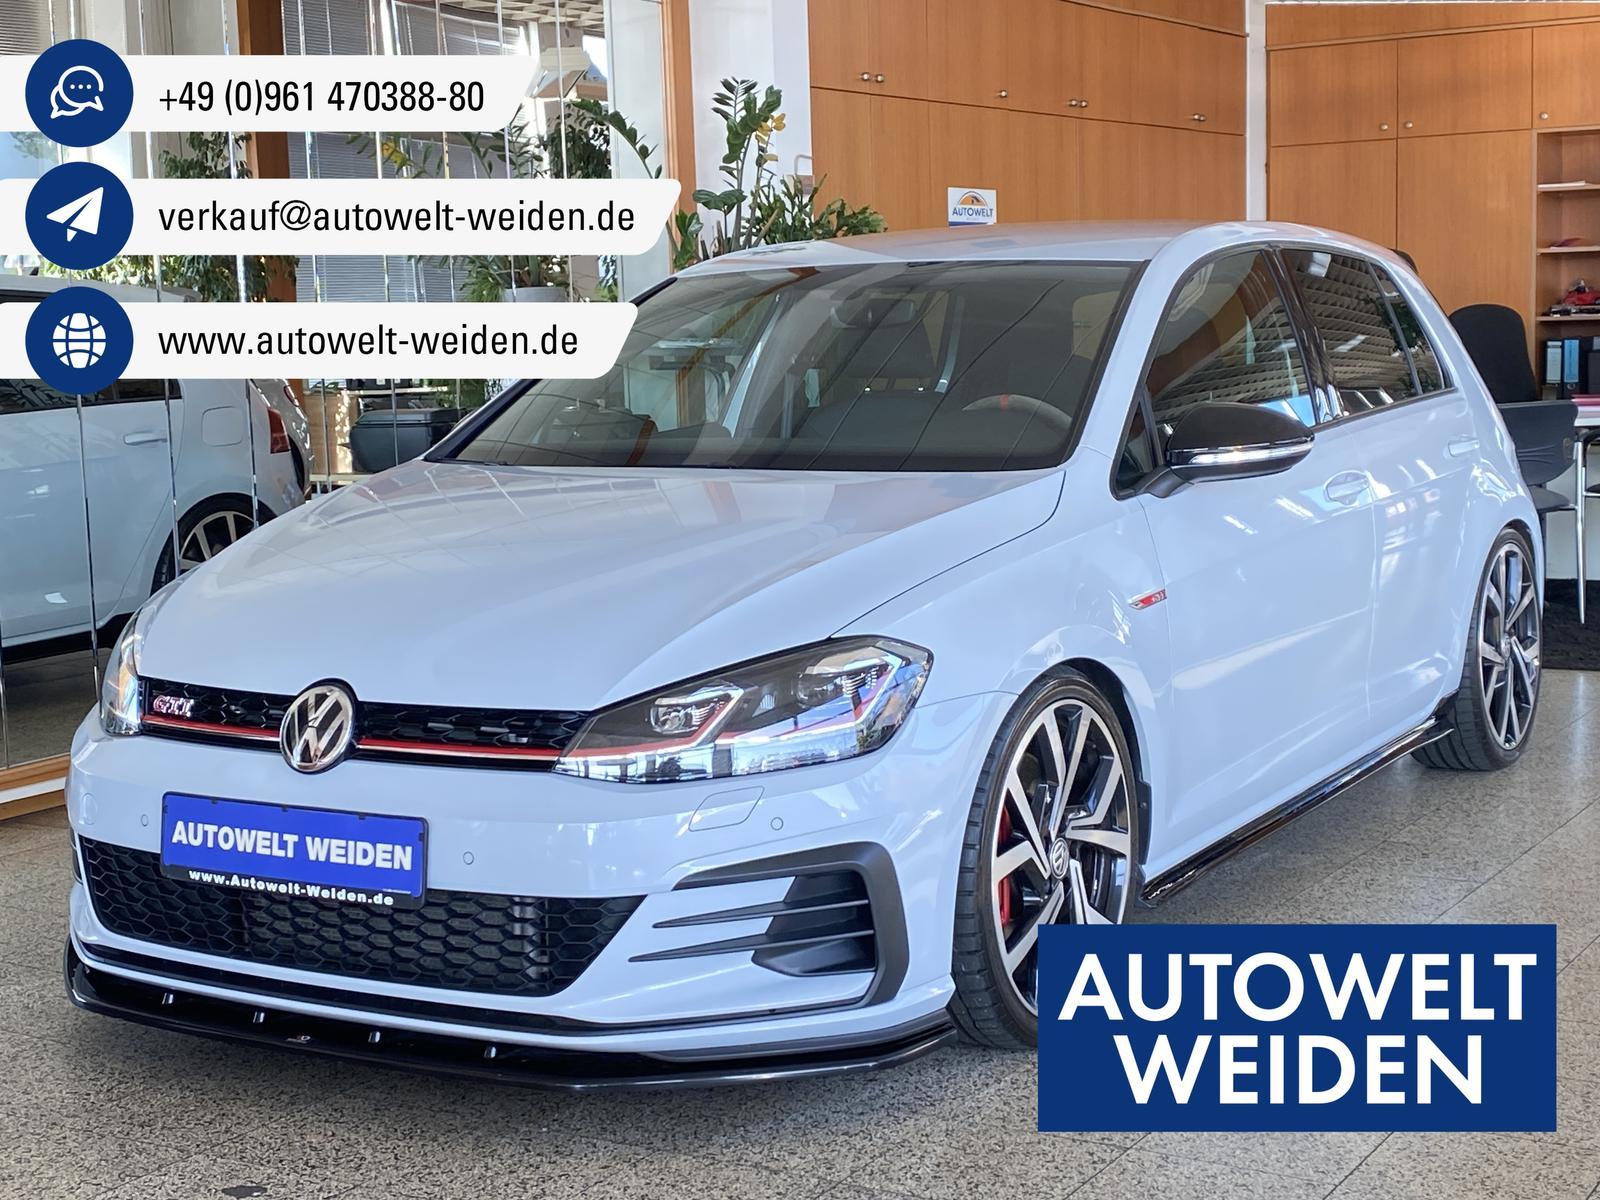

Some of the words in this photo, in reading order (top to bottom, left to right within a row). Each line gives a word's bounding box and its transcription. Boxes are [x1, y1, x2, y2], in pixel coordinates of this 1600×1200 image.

[952, 207, 993, 218] AUTOWELT
[153, 694, 194, 718] GTI
[171, 820, 299, 859] AUTOWELT
[305, 836, 413, 871] WEIDEN
[188, 870, 395, 906] www.Autowelt-Weiden.de
